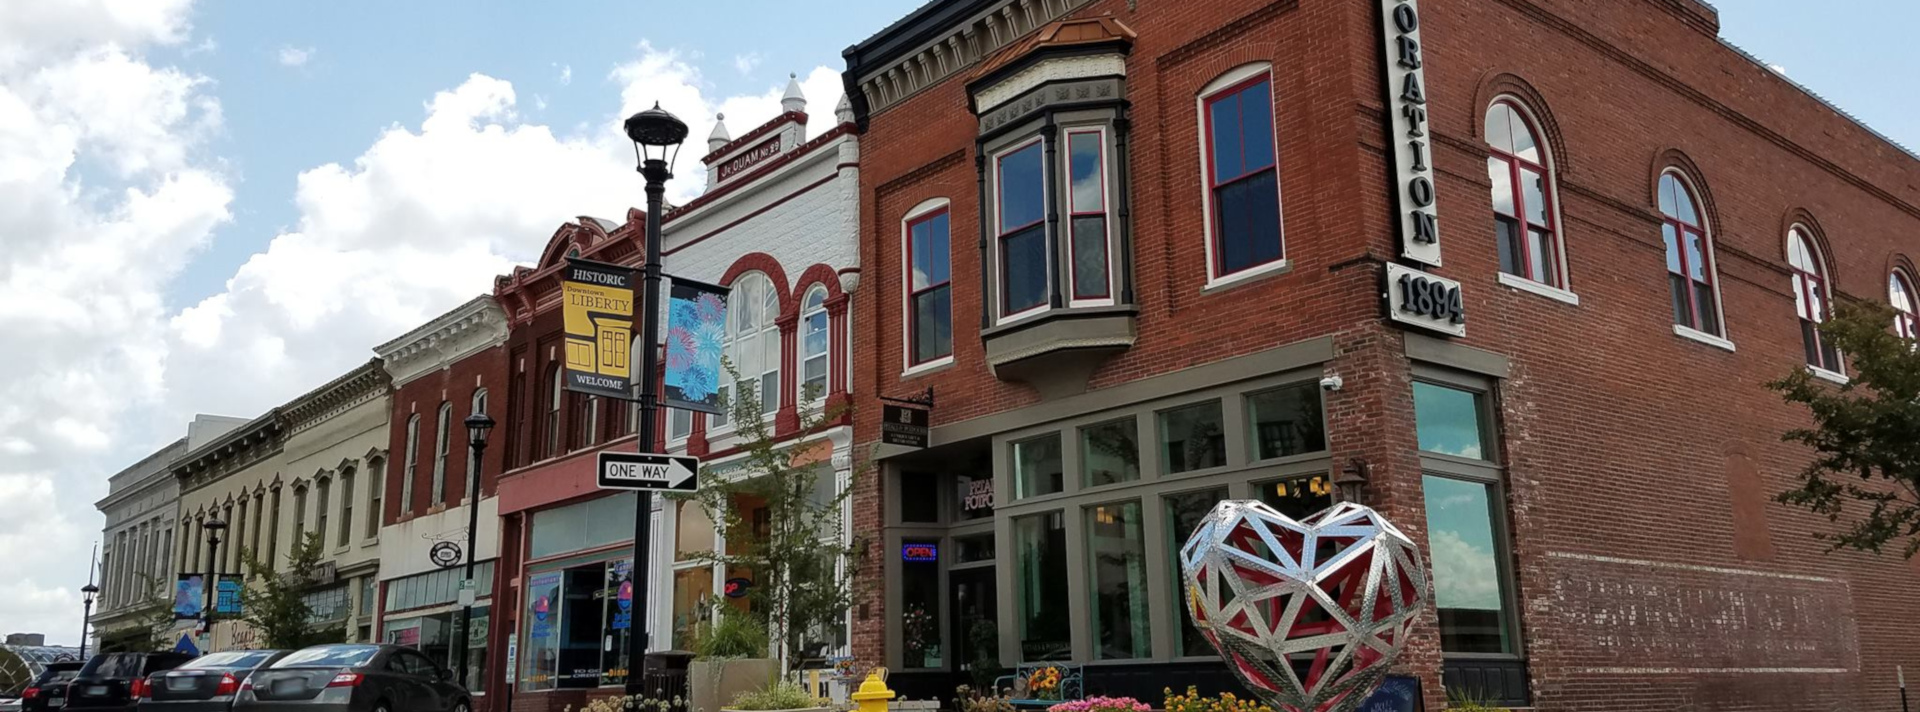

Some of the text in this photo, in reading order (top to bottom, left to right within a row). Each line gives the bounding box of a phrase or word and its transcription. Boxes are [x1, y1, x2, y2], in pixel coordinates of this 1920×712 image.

[1393, 0, 1437, 244] ORATION
[573, 269, 625, 286] HISTORIC
[567, 286, 604, 296] Downtown
[1398, 273, 1464, 324] 1894
[571, 294, 630, 312] LIBERTY
[576, 374, 623, 390] WELCOME
[609, 463, 669, 479] ONE WAY
[906, 547, 933, 557] OPEN
